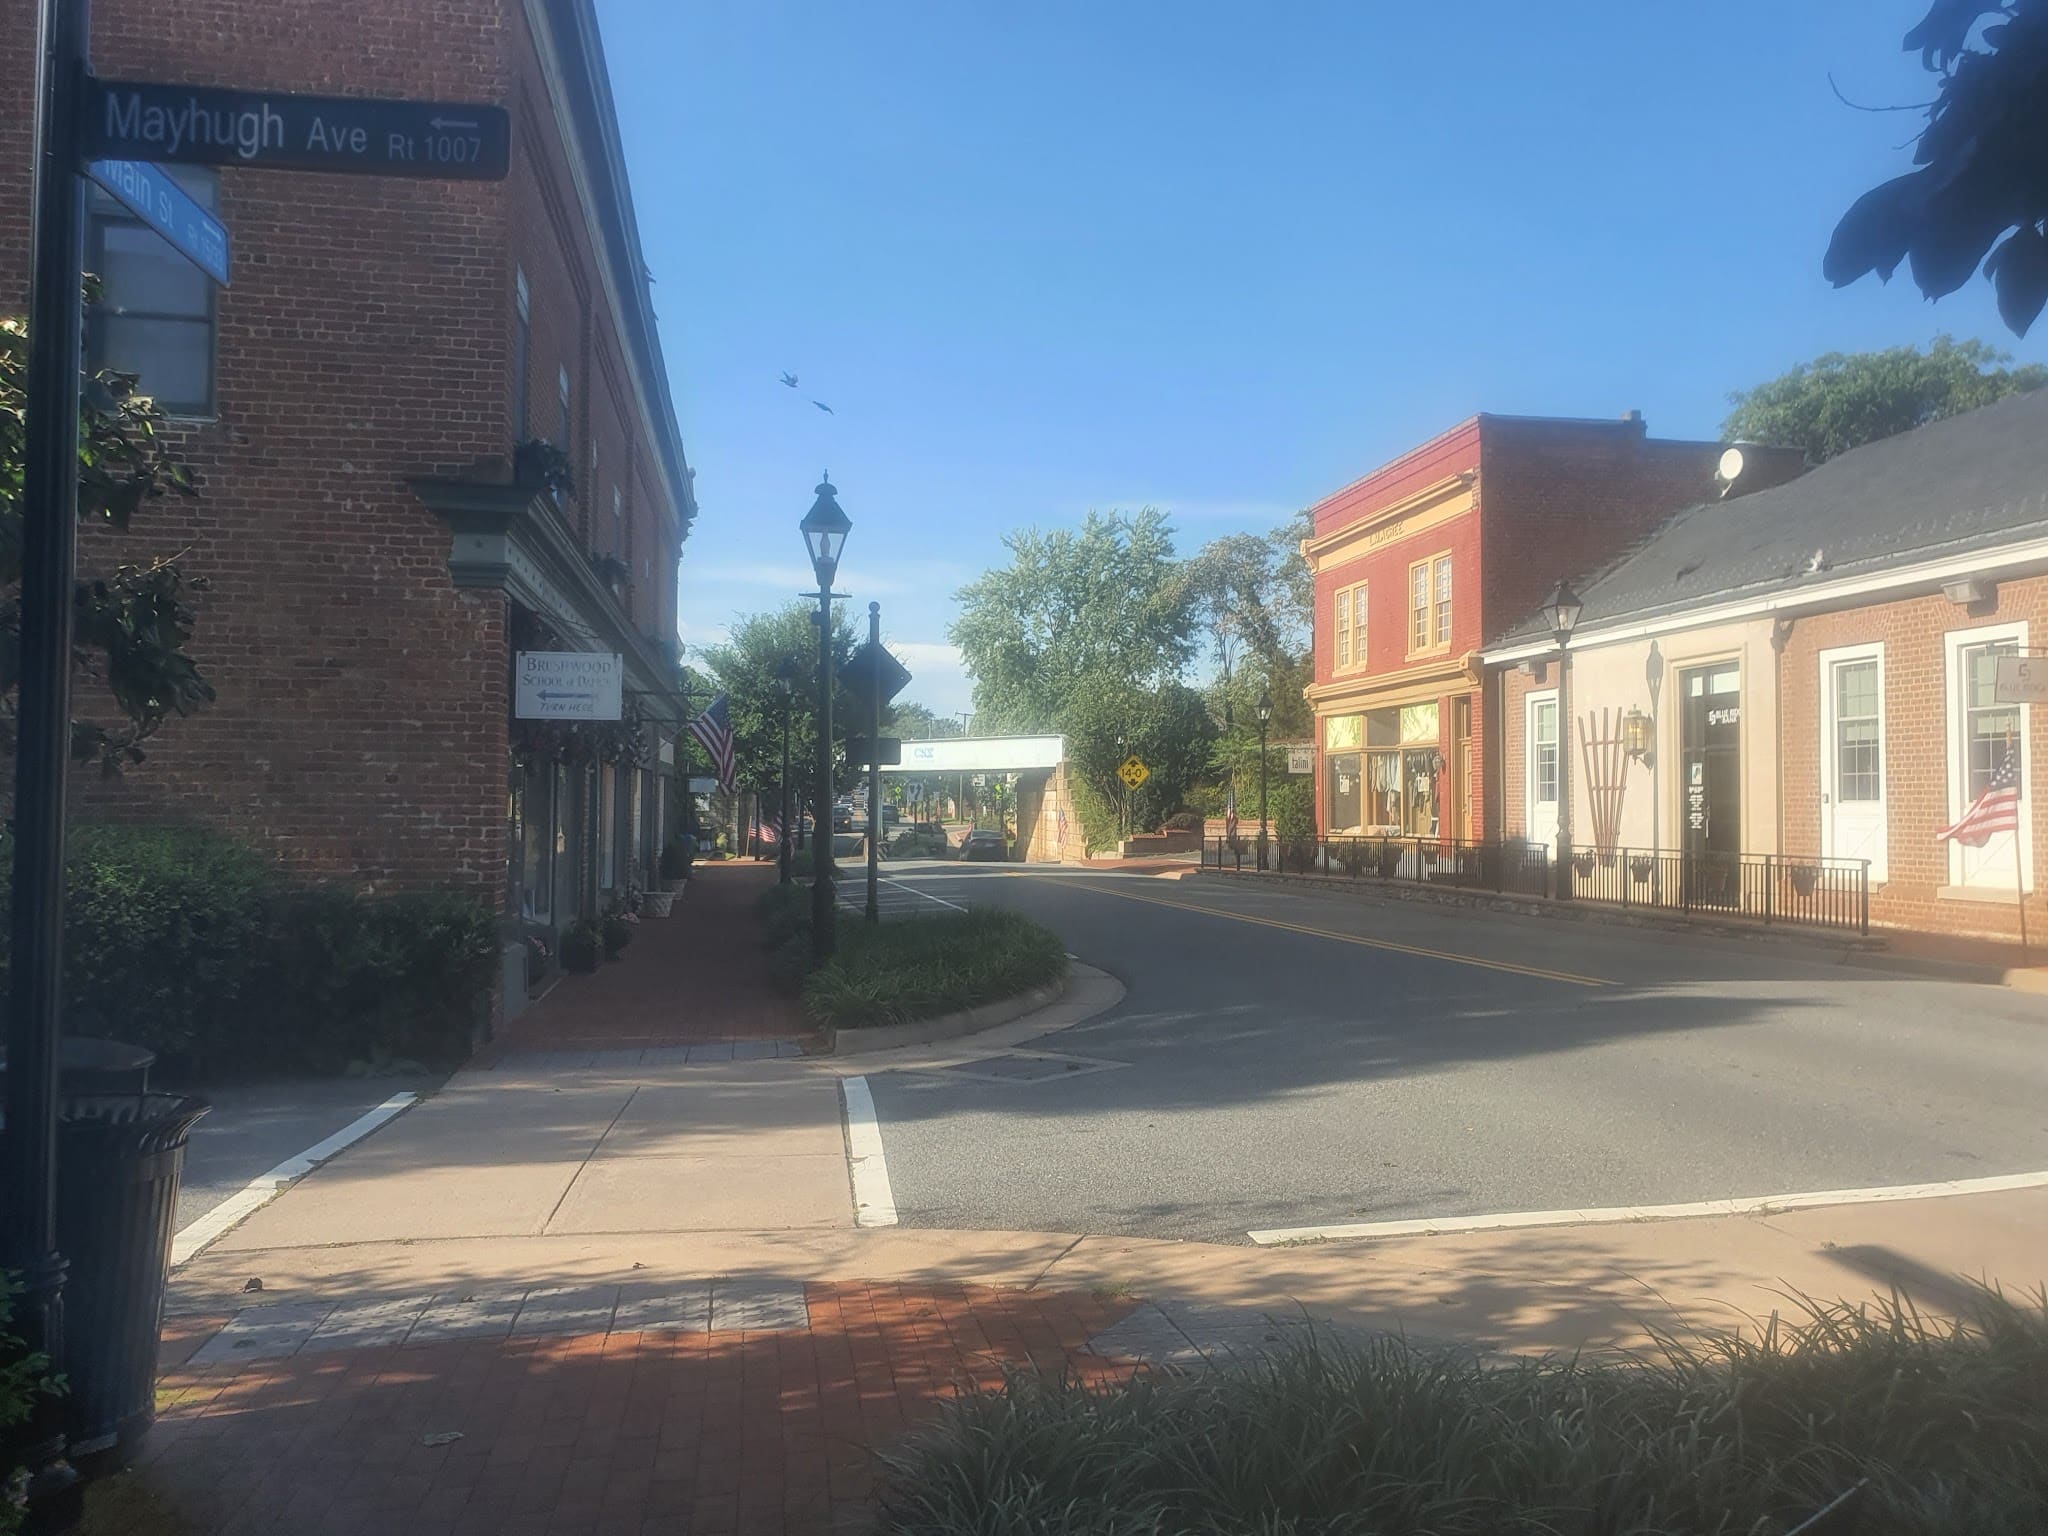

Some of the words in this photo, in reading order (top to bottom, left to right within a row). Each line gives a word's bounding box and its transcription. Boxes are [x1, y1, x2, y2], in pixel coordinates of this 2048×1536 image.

[107, 92, 284, 158] Mayhugh
[307, 117, 367, 153] Ave
[388, 134, 414, 160] Rt
[425, 136, 481, 162] 1007
[160, 191, 174, 229] St
[527, 657, 612, 673] BRUSHWOOD
[523, 674, 562, 687] SCHOOL
